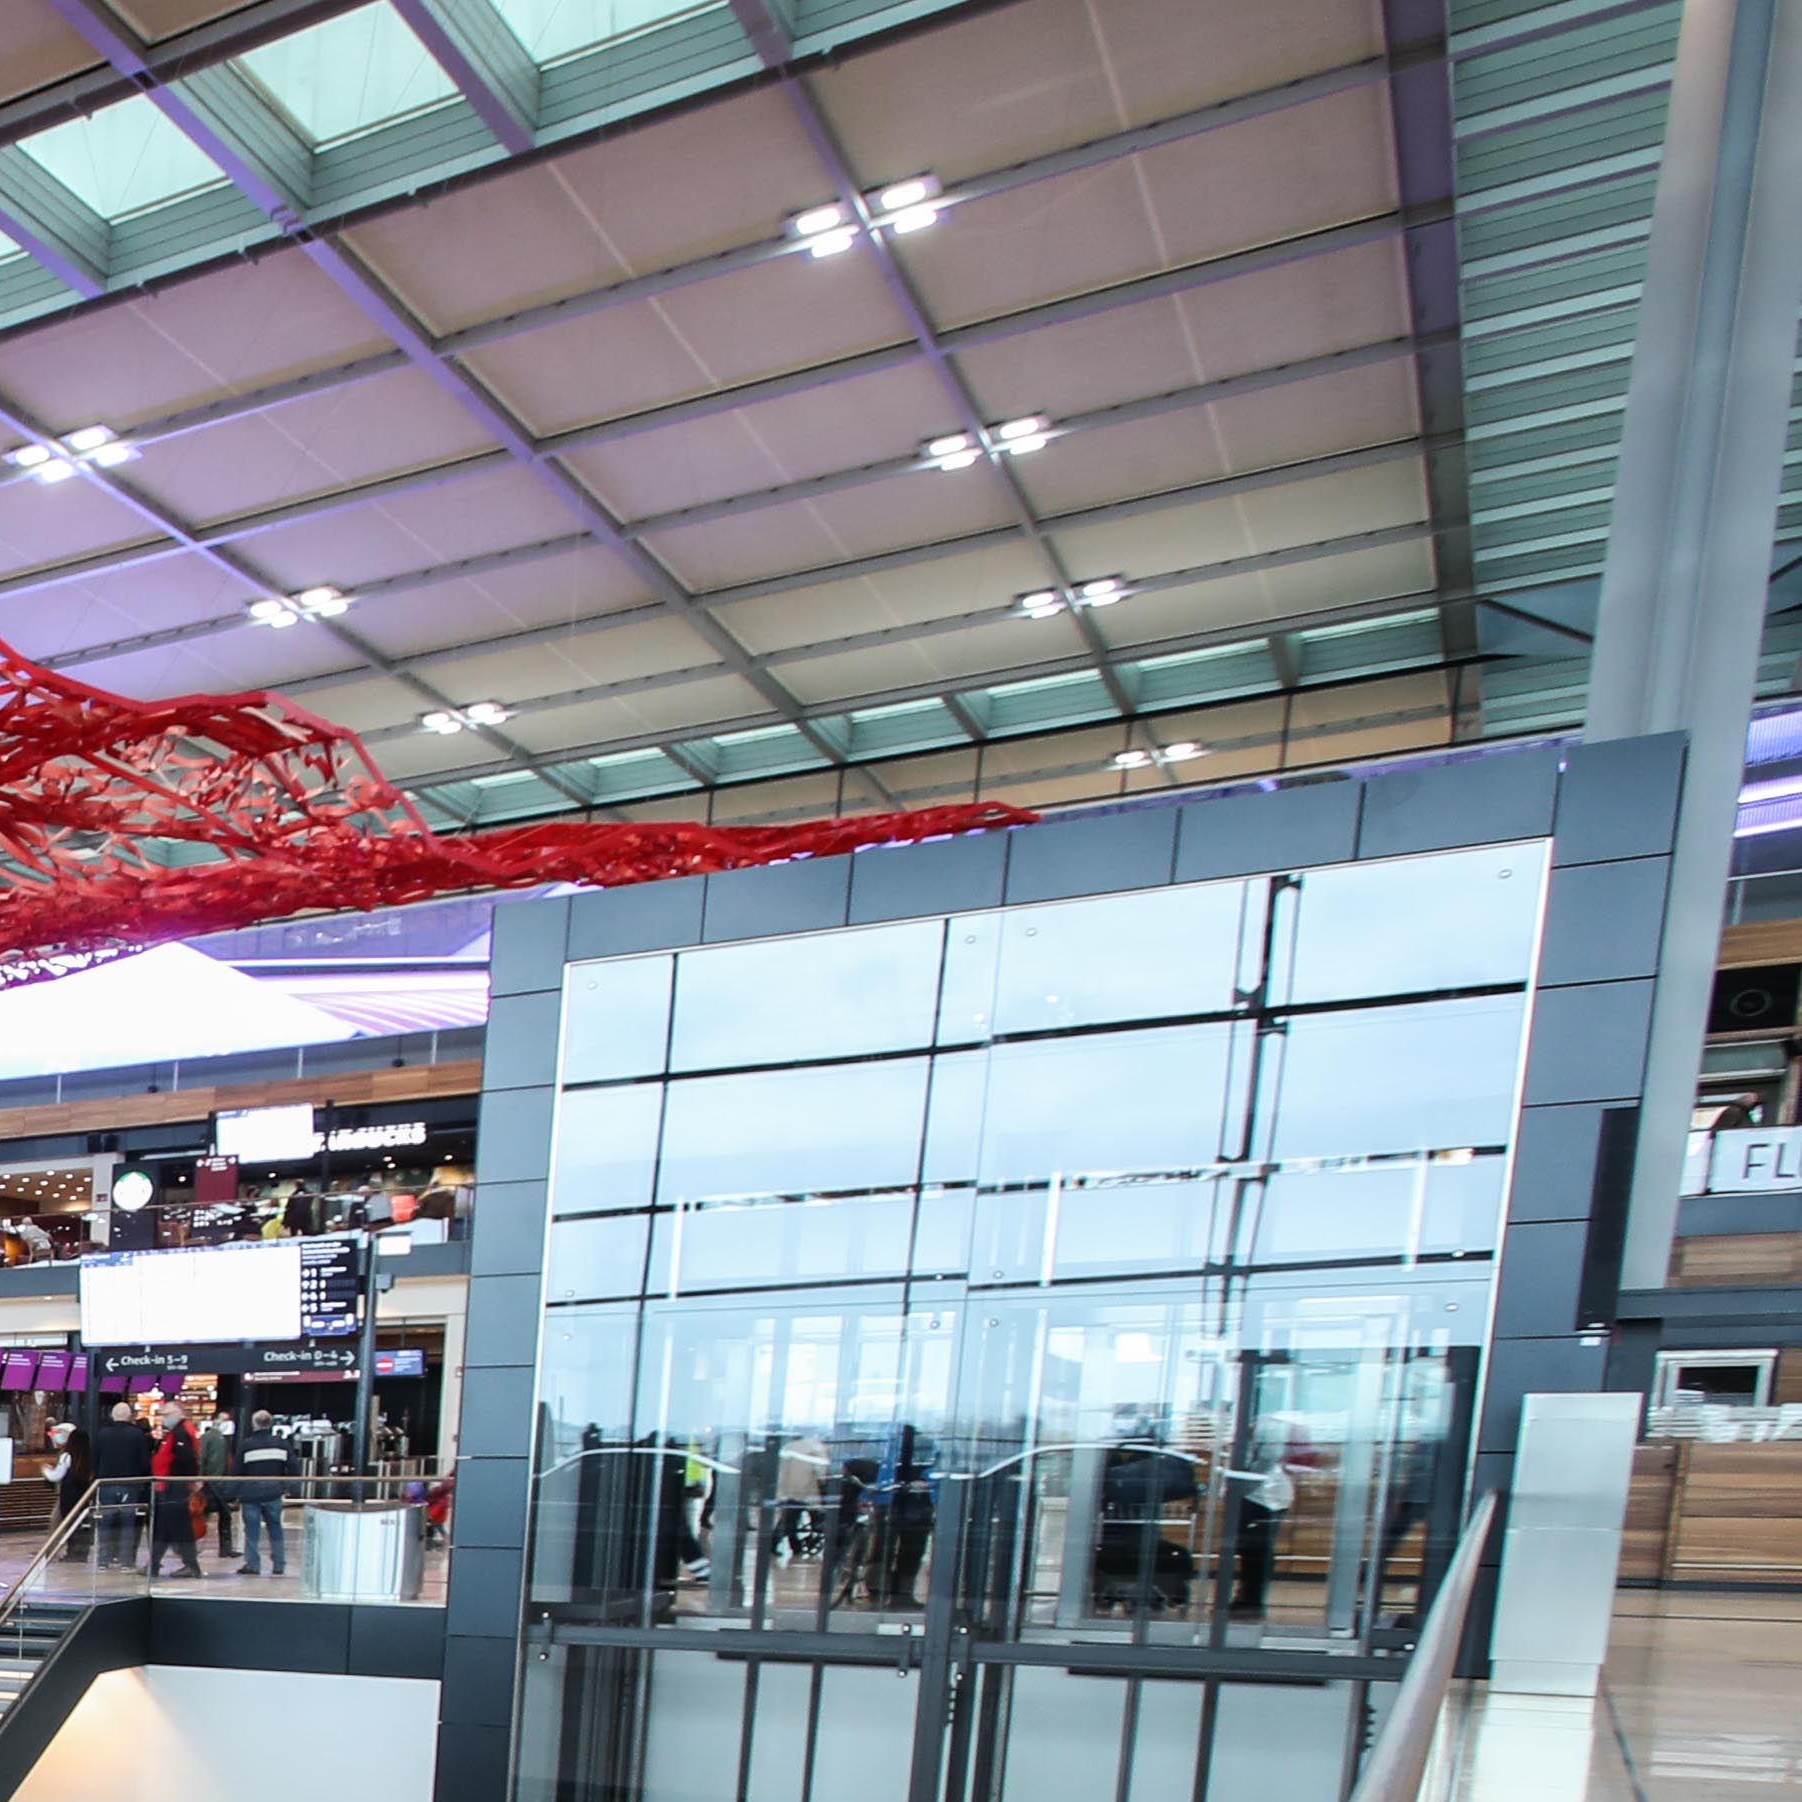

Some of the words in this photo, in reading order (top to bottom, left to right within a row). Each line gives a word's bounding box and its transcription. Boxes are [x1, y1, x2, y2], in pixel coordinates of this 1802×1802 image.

[1742, 1142, 1802, 1179] FL
[120, 1355, 165, 1366] Check-in
[264, 1350, 312, 1362] Check-in
